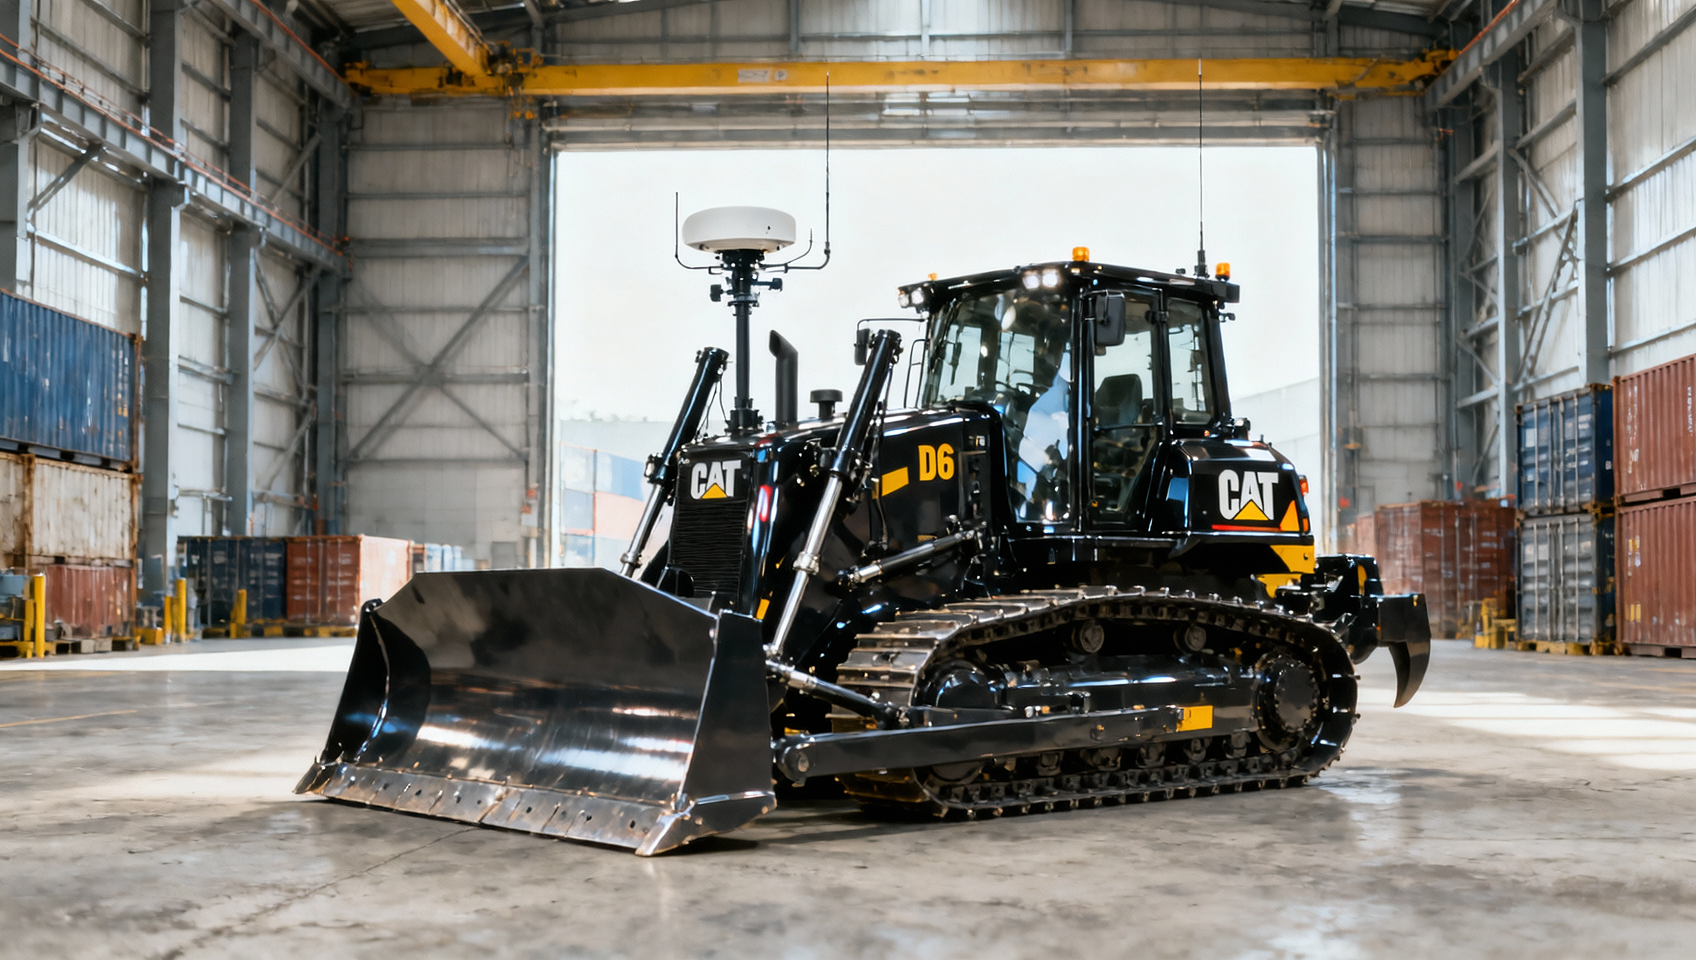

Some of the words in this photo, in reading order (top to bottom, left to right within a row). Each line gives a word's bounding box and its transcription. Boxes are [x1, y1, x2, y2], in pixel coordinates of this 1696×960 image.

[690, 459, 741, 499] CAT
[918, 442, 955, 482] D6
[1218, 469, 1279, 520] CAT
